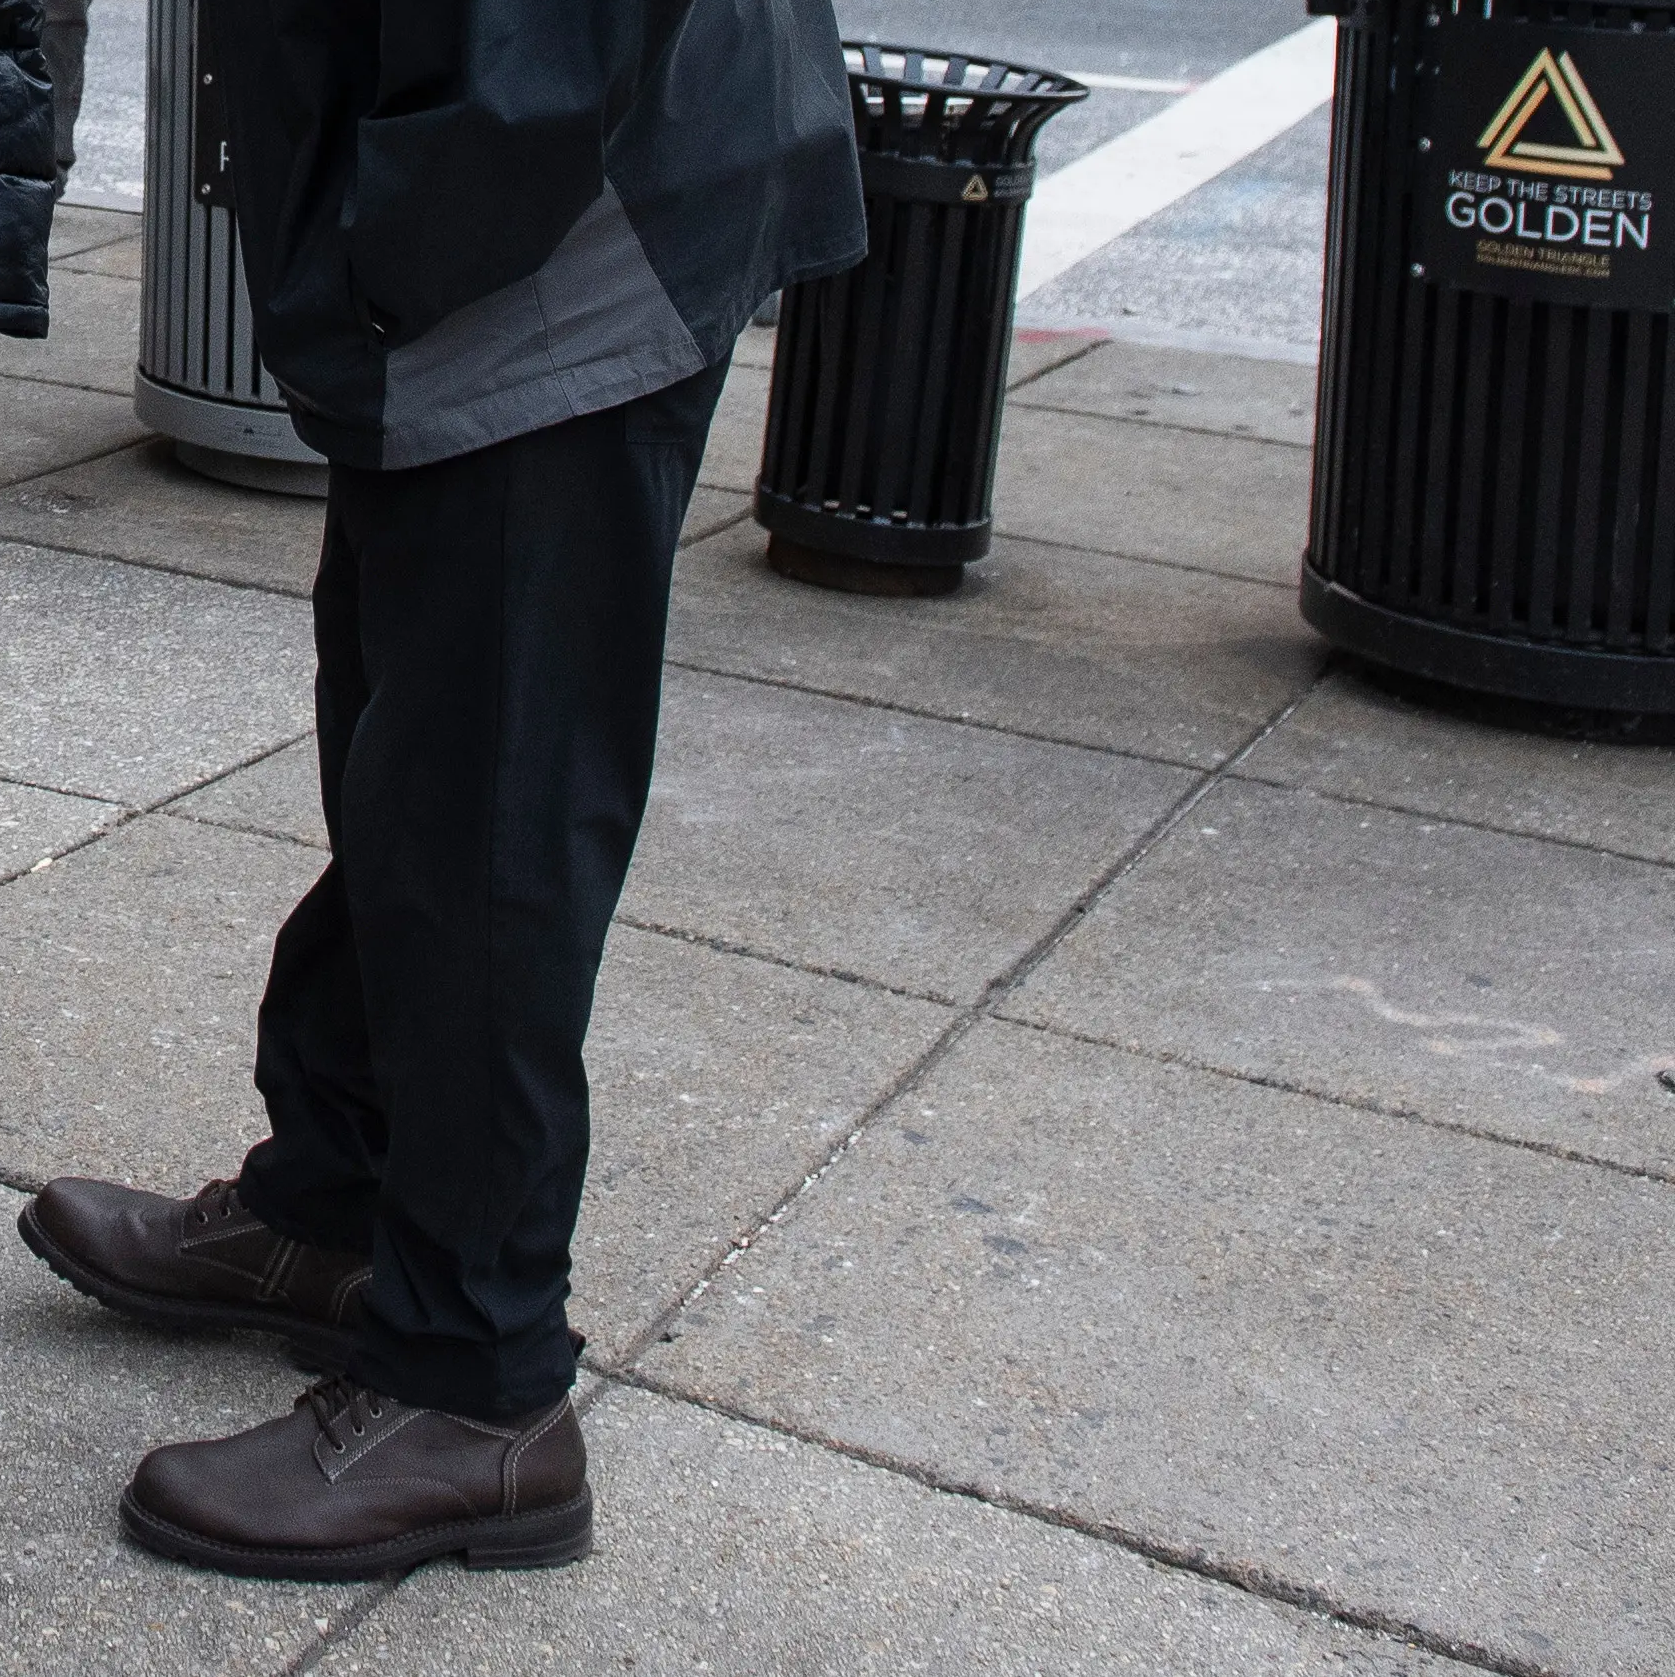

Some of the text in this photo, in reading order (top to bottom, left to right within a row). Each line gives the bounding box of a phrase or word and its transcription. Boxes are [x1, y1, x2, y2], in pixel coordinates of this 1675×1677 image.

[1448, 170, 1653, 211] KEEP THE STREETS
[1445, 190, 1650, 251] GOLDEN
[1476, 238, 1611, 267] GOLDEN TRIANGLE
